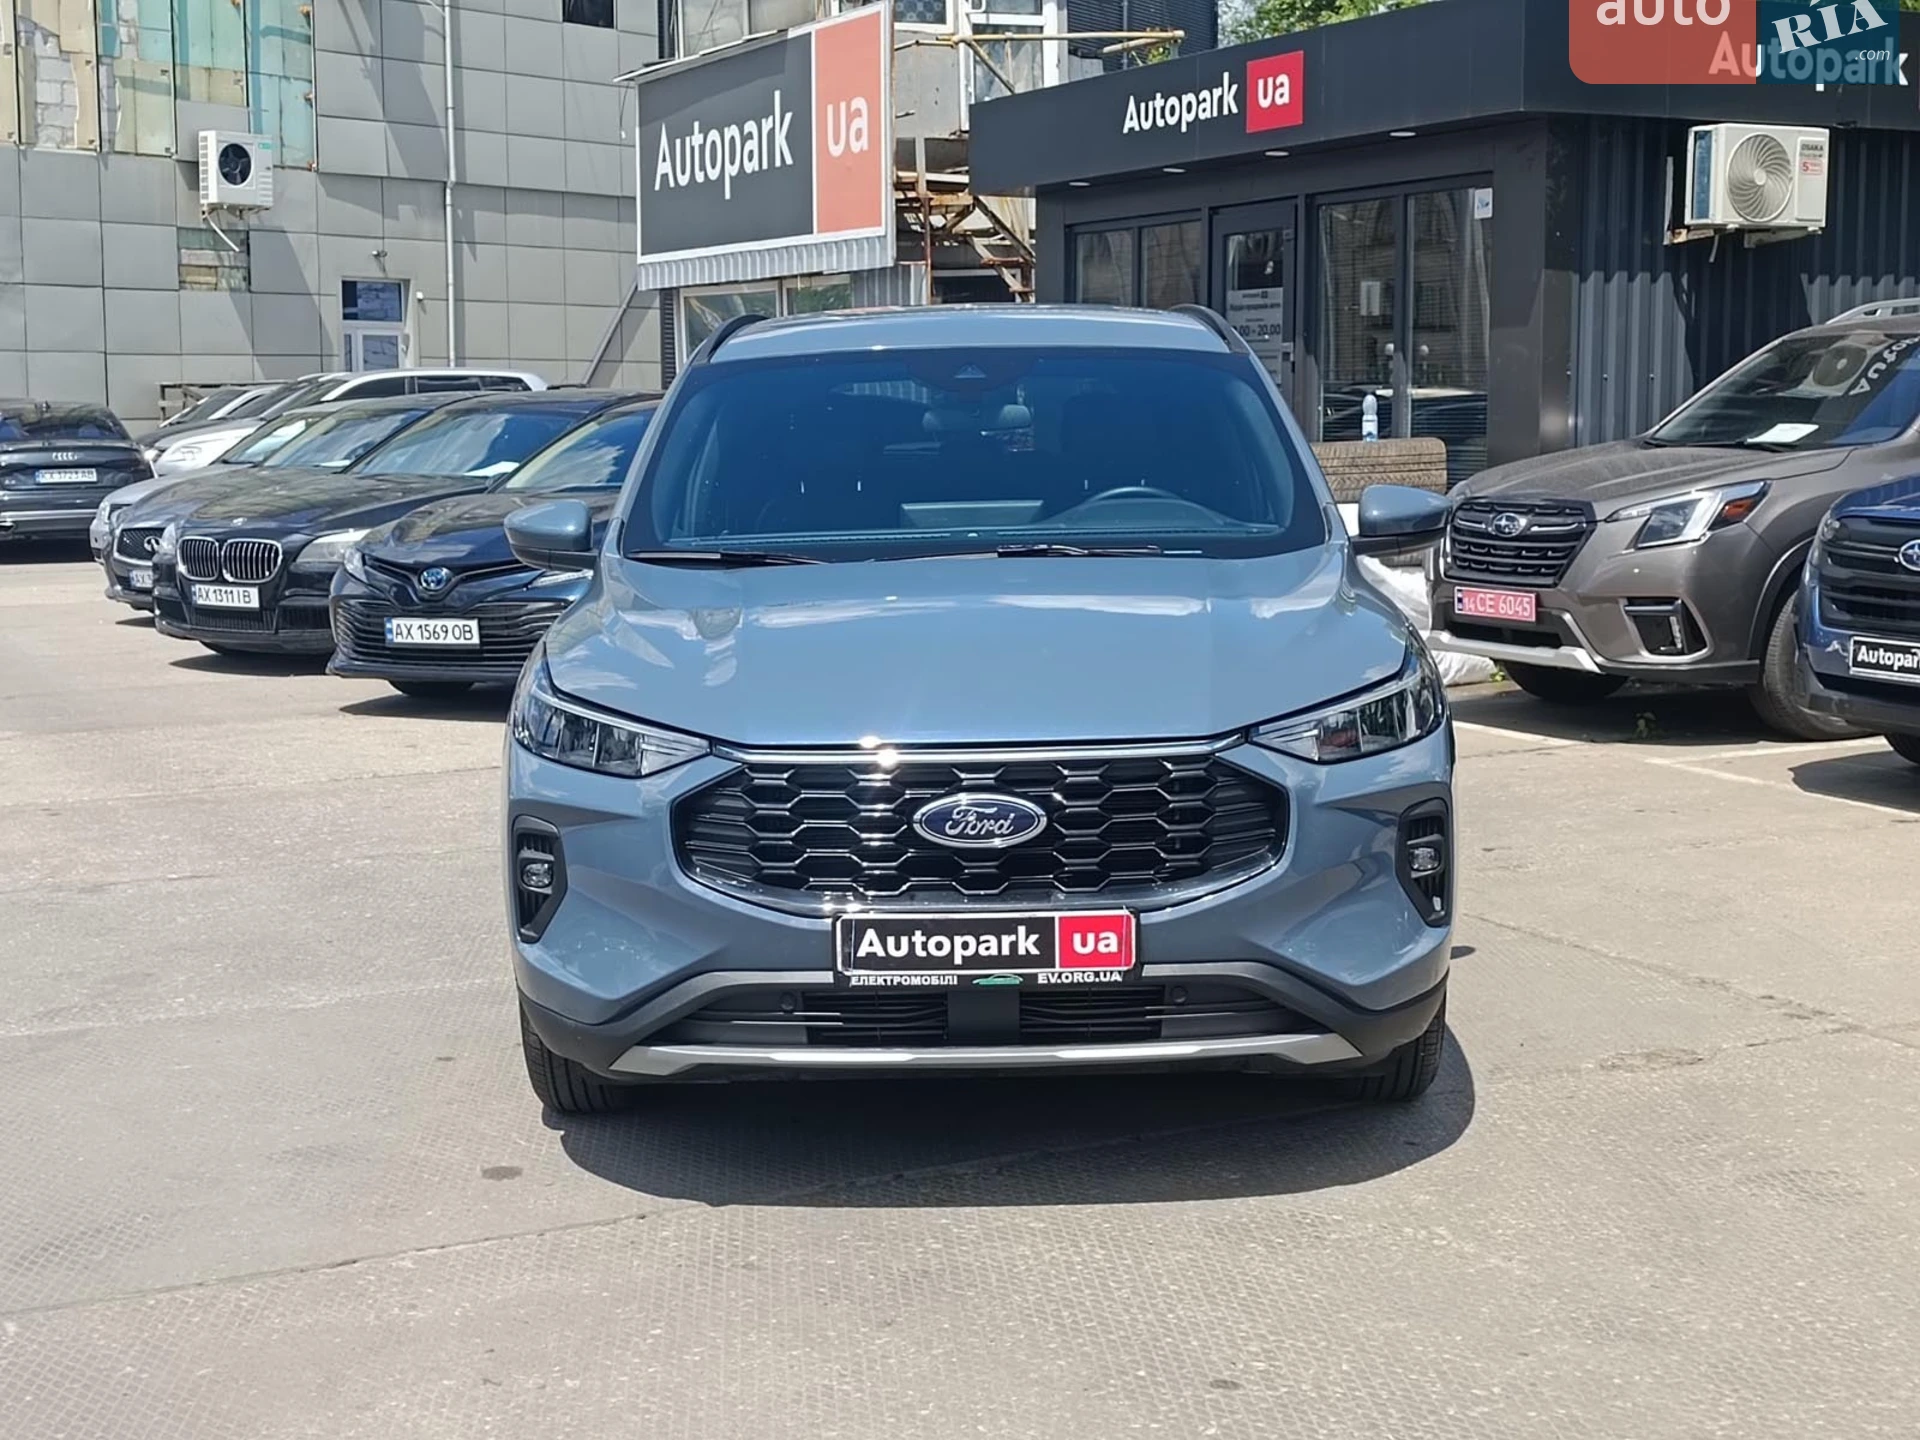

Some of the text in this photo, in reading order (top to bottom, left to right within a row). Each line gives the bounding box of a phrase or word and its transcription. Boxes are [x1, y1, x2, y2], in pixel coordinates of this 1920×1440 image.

[1708, 31, 1909, 92] Autopark
[1122, 71, 1290, 134] Autopark ua
[654, 89, 869, 200] Autopark ua
[197, 587, 251, 604] AX 1311 IB
[1476, 593, 1496, 613] CE
[1498, 595, 1532, 617] 6045
[395, 623, 414, 641] AX
[417, 624, 449, 641] 1569
[451, 624, 474, 641] OB
[944, 805, 1015, 836] Ford
[856, 925, 1119, 966] Autopark ua
[851, 975, 958, 986] ЕЛЕКТРОМОБІЛІ
[1037, 971, 1123, 984] EV.ORG.UA
